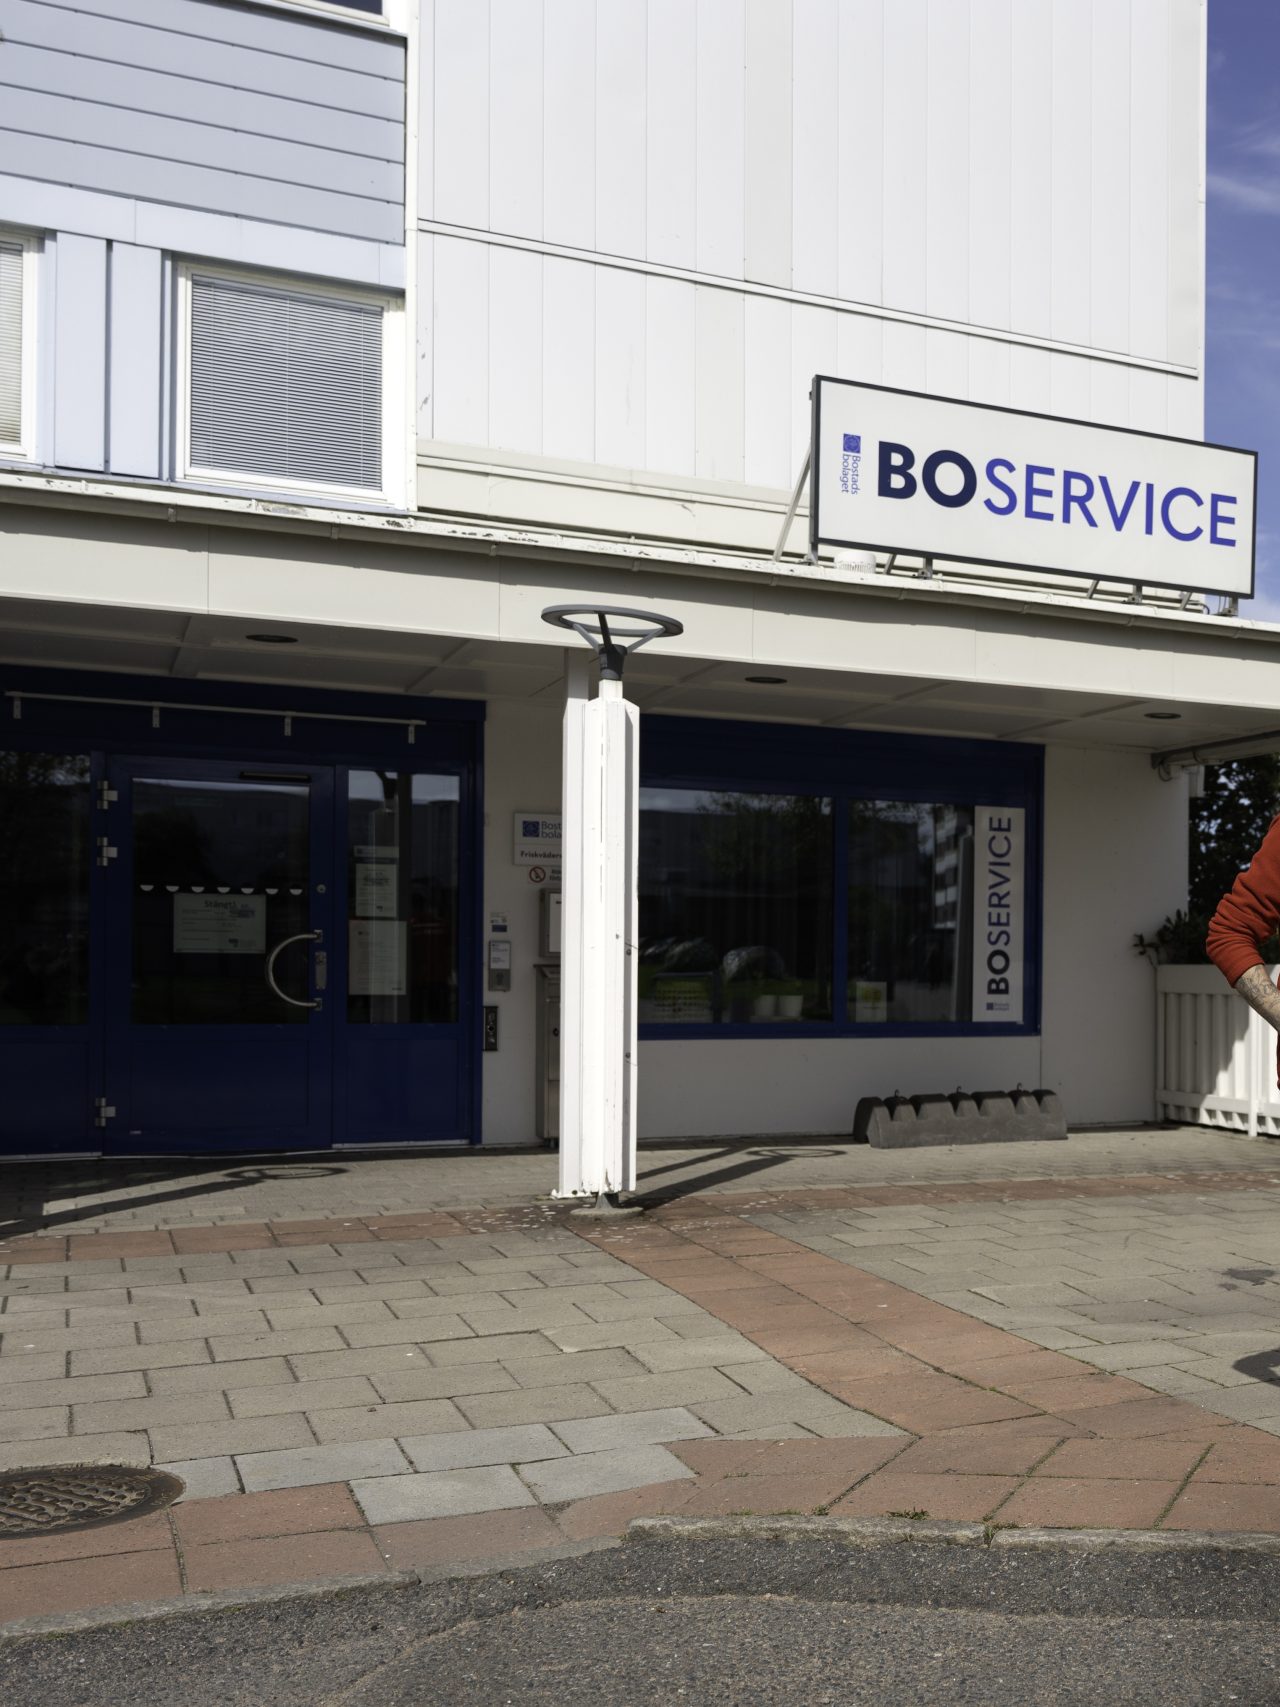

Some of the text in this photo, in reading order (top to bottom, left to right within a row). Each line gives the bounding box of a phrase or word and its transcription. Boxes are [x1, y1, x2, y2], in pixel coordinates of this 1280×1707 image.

[840, 453, 851, 493] bolaget
[851, 455, 861, 495] Bostads
[878, 440, 1237, 547] BOSERVICE
[541, 821, 561, 830] Bost
[541, 830, 561, 838] bola
[520, 850, 562, 858] Friskväder
[987, 816, 1011, 995] BOSERVICE
